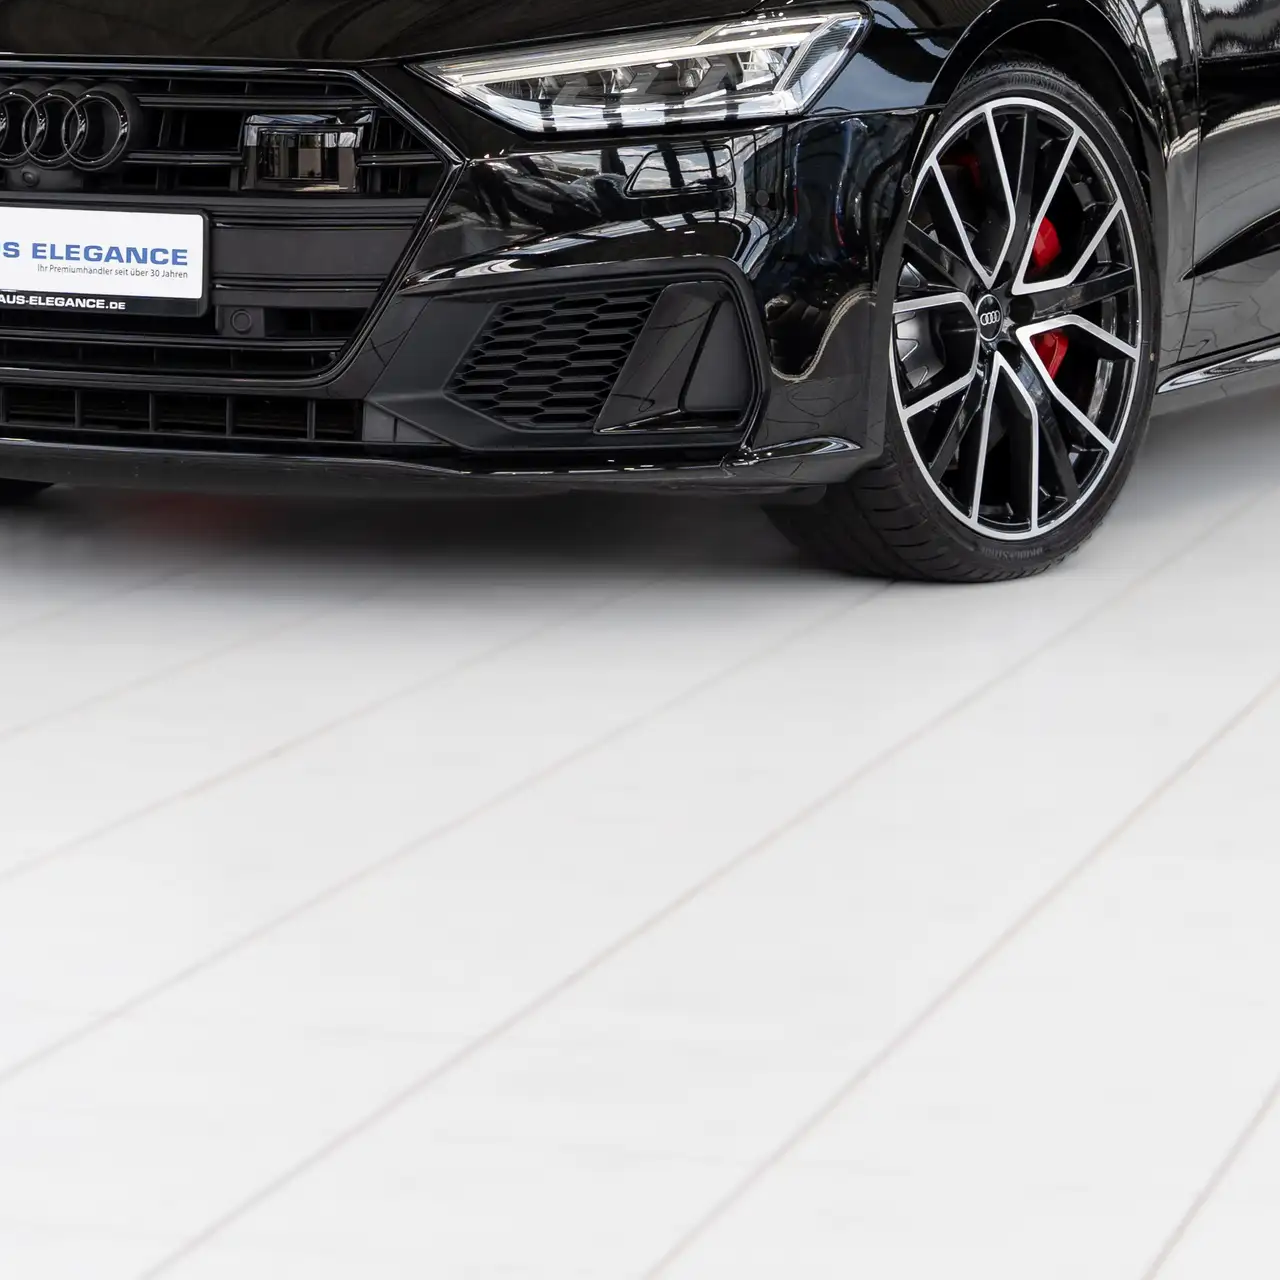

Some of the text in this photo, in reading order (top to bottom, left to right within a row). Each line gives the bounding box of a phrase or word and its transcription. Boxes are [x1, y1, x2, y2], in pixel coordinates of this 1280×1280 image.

[31, 242, 188, 266] ELEGANCE
[37, 263, 48, 273] Ihr
[114, 267, 129, 277] seit
[130, 267, 148, 277] über
[150, 269, 160, 278] 30
[161, 269, 188, 280] Jahren
